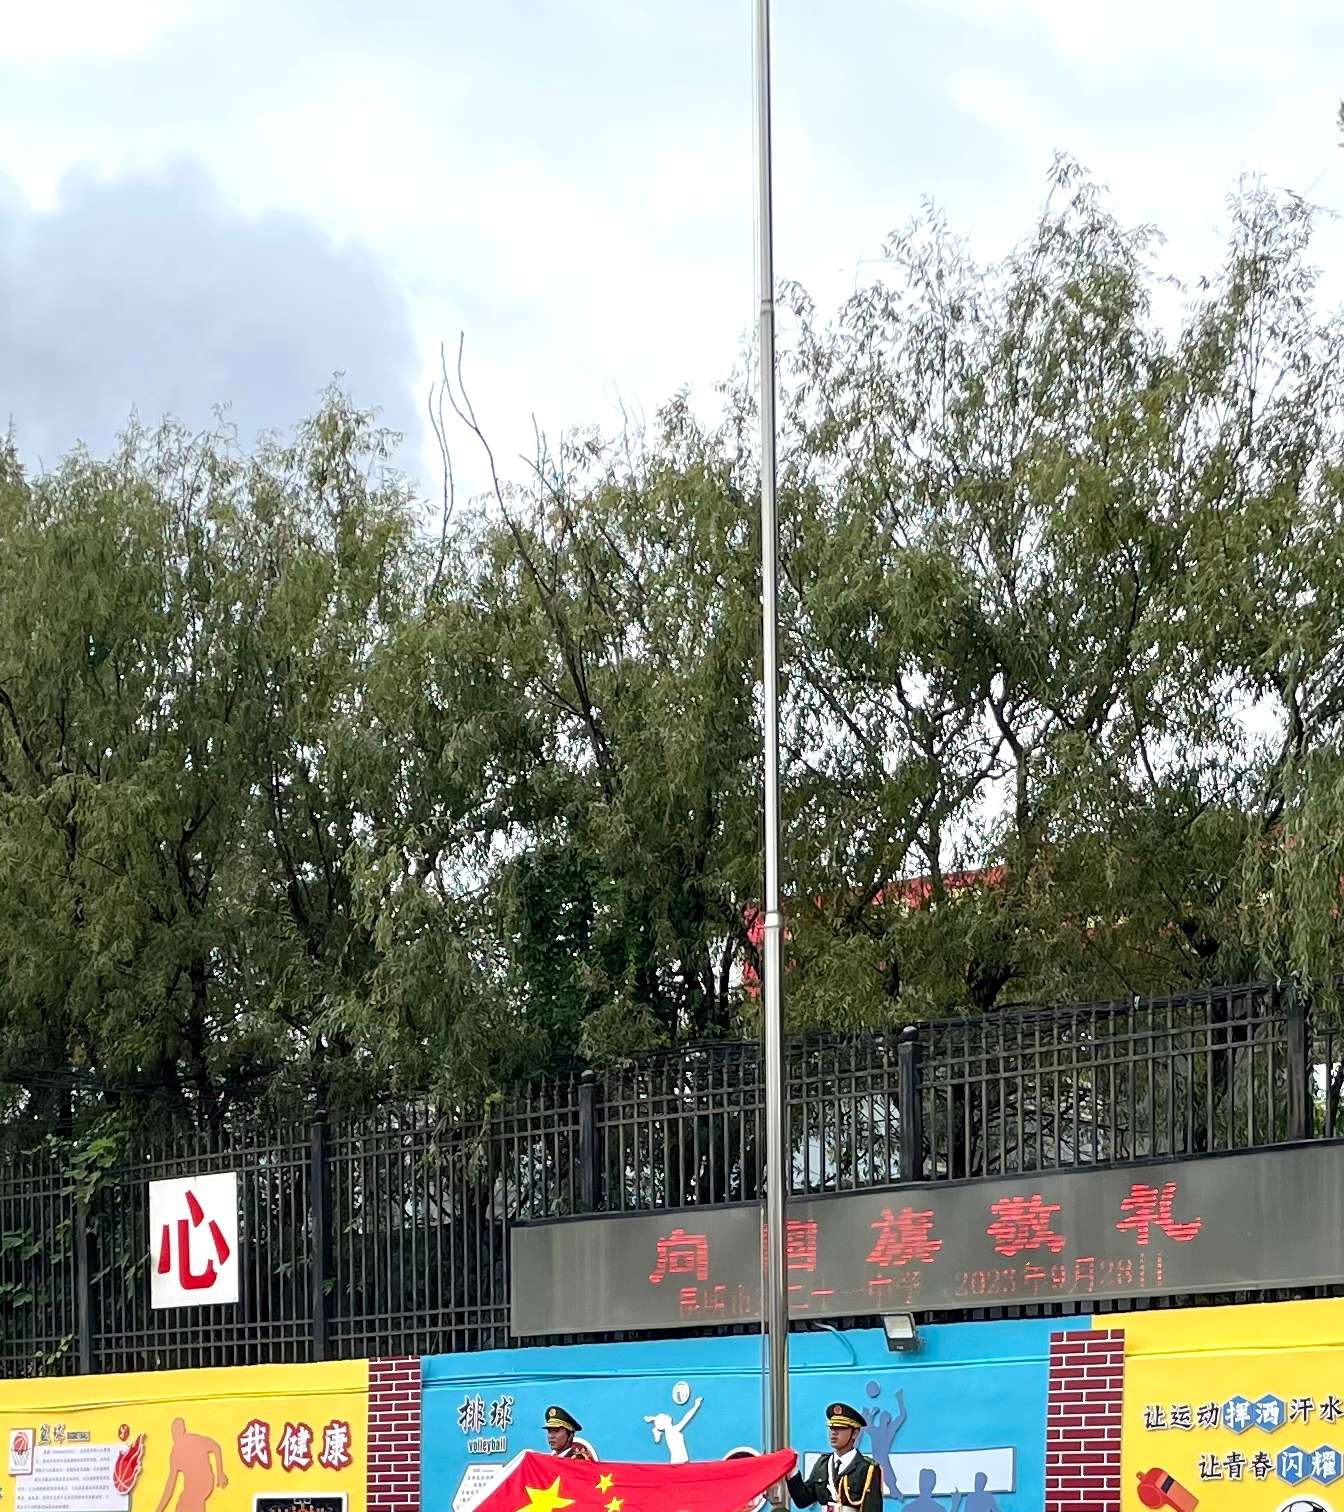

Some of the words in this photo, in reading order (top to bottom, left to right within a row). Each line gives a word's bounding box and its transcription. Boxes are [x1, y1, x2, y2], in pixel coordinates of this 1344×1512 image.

[157, 1189, 231, 1291] 心
[649, 1182, 1203, 1283] 向国旗敬礼
[457, 1394, 513, 1433] 排球
[1143, 1395, 1344, 1431] 让运动挥洒汗水
[238, 1420, 353, 1472] 我健康
[468, 1437, 507, 1454] volleyball
